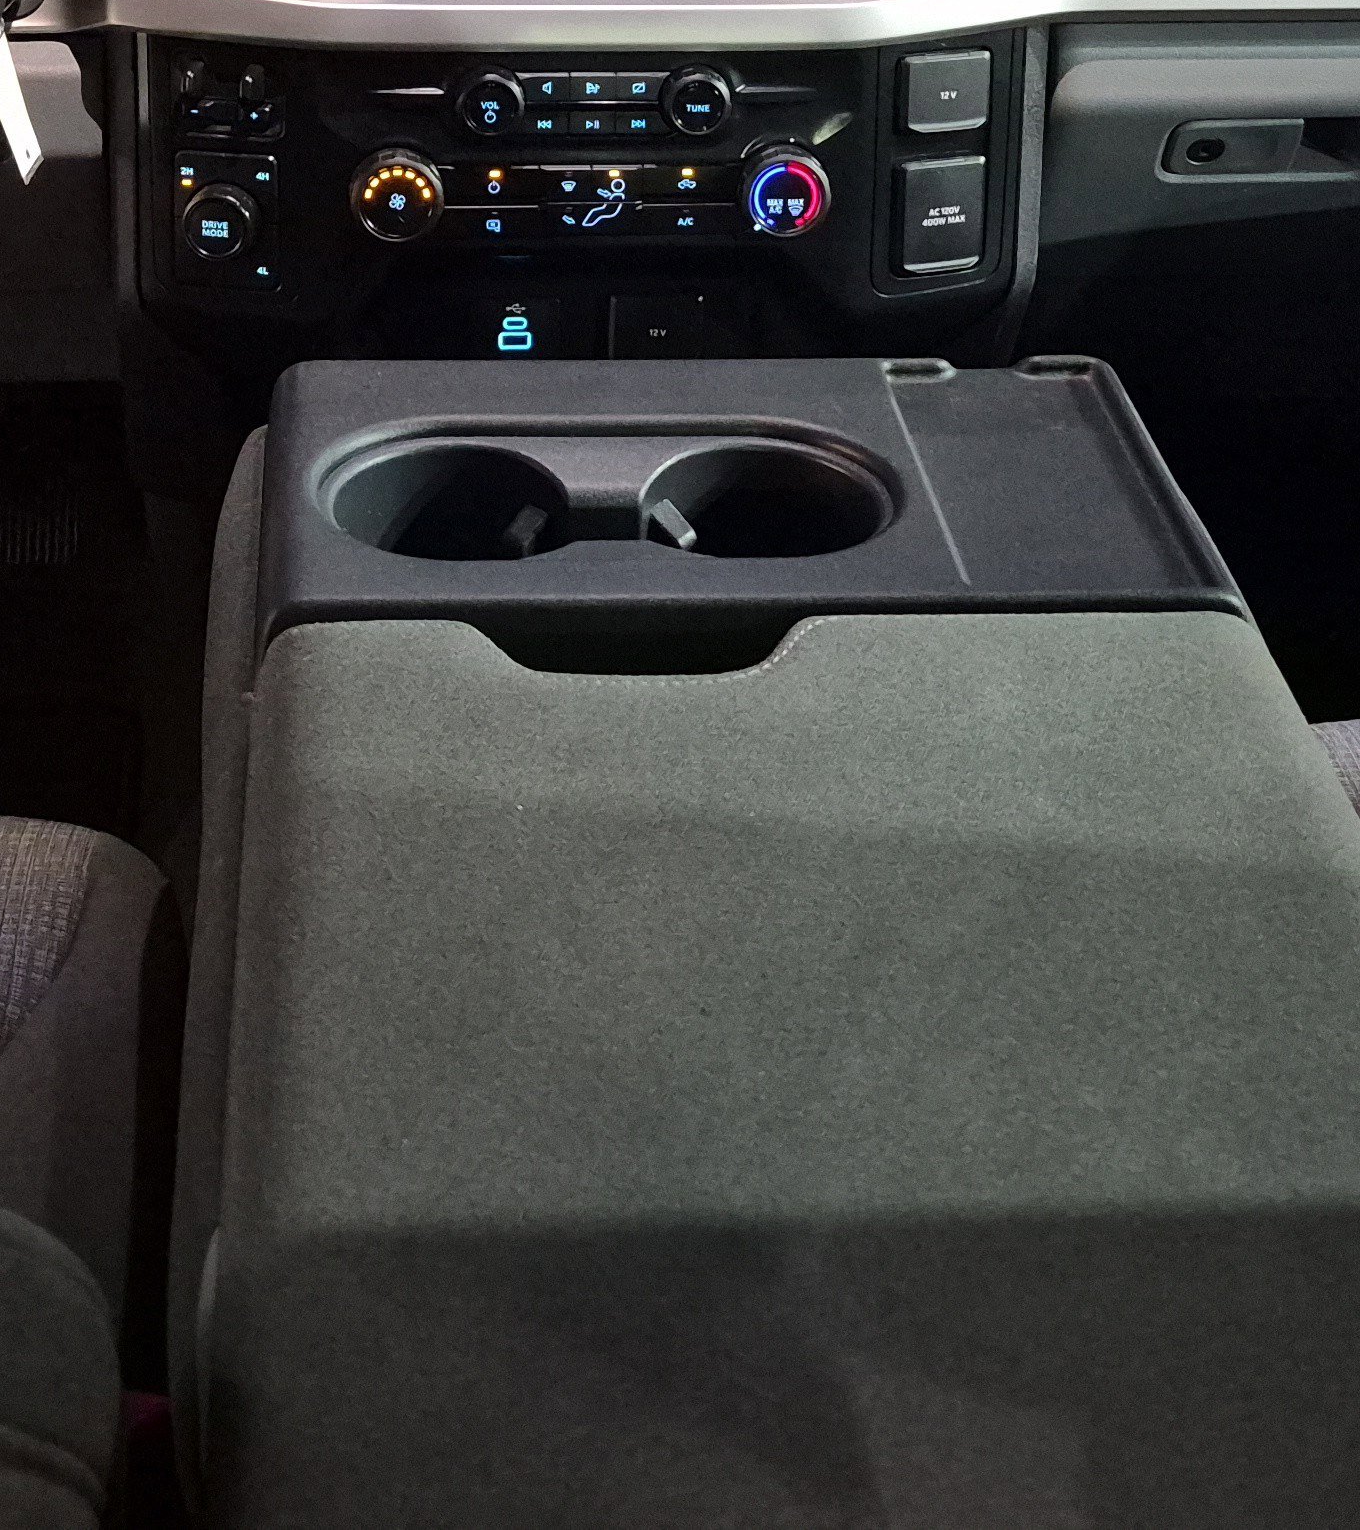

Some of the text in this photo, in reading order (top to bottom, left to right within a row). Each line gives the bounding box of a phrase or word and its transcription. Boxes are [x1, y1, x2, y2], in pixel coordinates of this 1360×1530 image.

[940, 90, 958, 100] 12 V
[480, 100, 500, 110] VOL
[685, 103, 711, 113] TUNE
[180, 166, 194, 176] 2H
[255, 171, 270, 181] 4H
[928, 208, 941, 217] AC
[201, 219, 229, 230] DRIVE
[677, 216, 695, 227] A/C
[947, 214, 966, 225] MAX
[201, 228, 229, 239] MODE
[256, 266, 270, 276] 4L
[649, 328, 667, 337] 12 V
